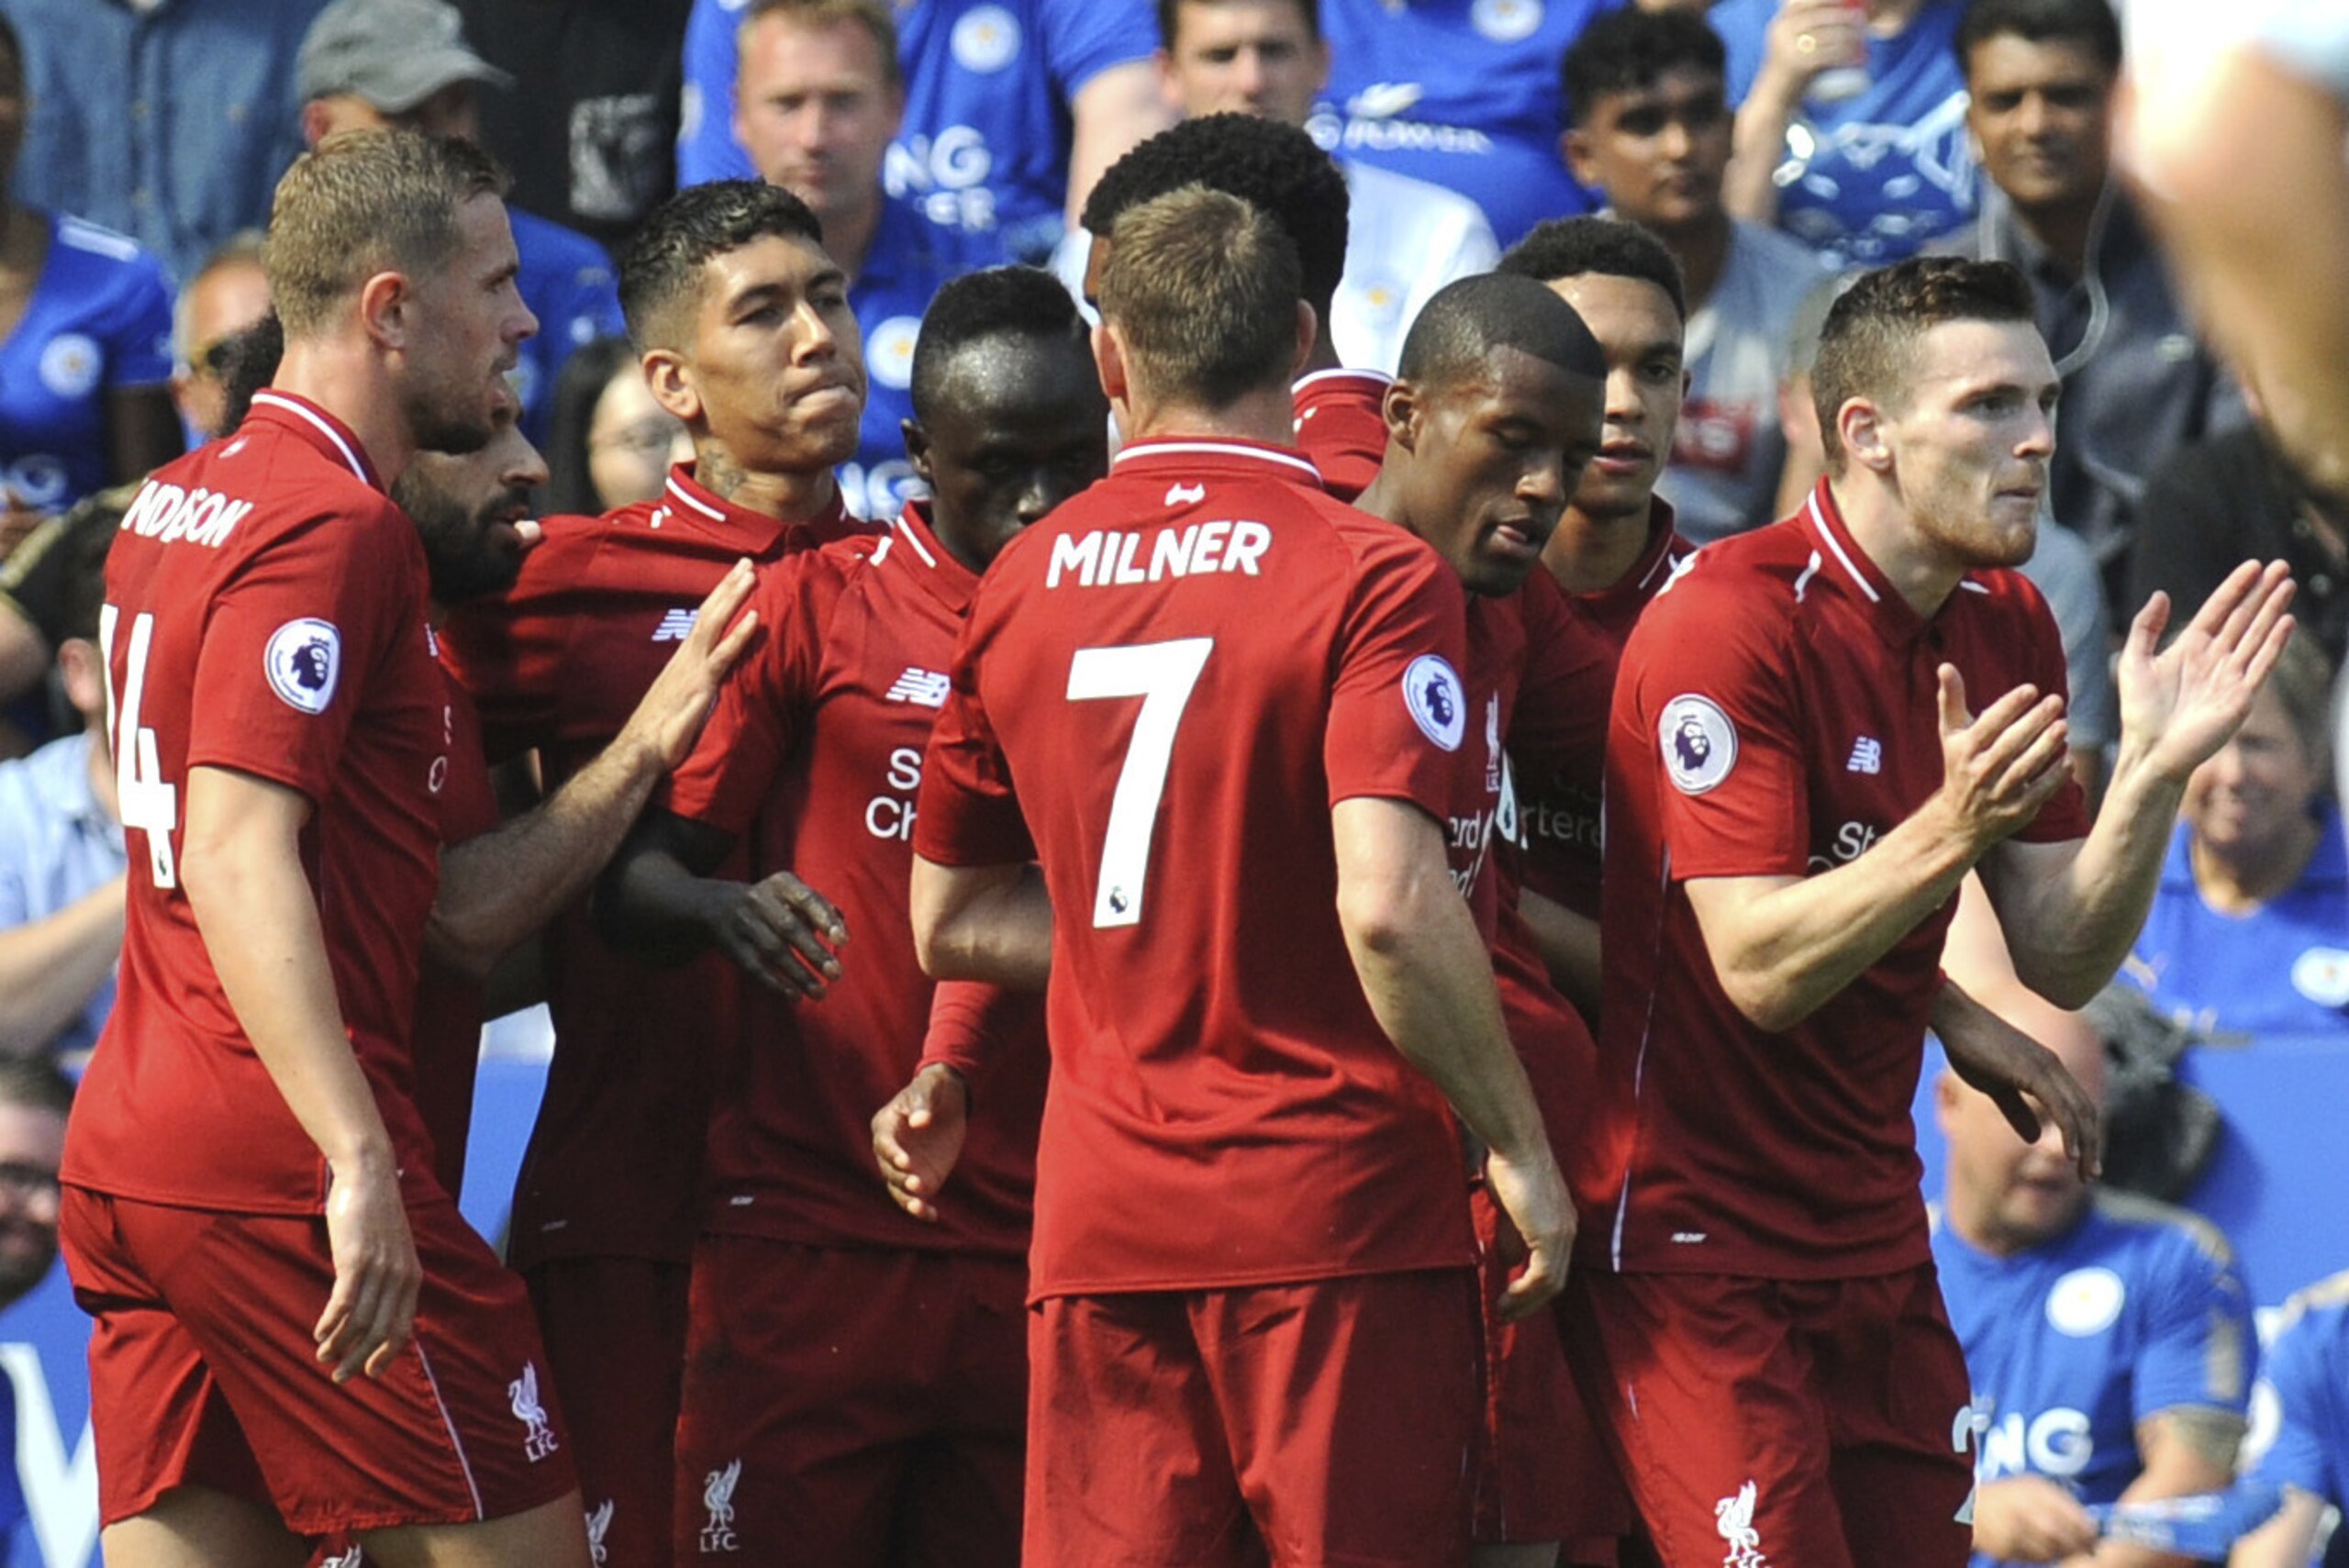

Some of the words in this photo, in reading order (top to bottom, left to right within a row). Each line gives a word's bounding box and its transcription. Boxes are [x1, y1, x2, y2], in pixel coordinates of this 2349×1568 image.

[1045, 520, 1273, 588] MILNER
[1066, 637, 1214, 929] 7
[525, 1428, 559, 1462] LFC
[699, 1532, 740, 1553] LFC
